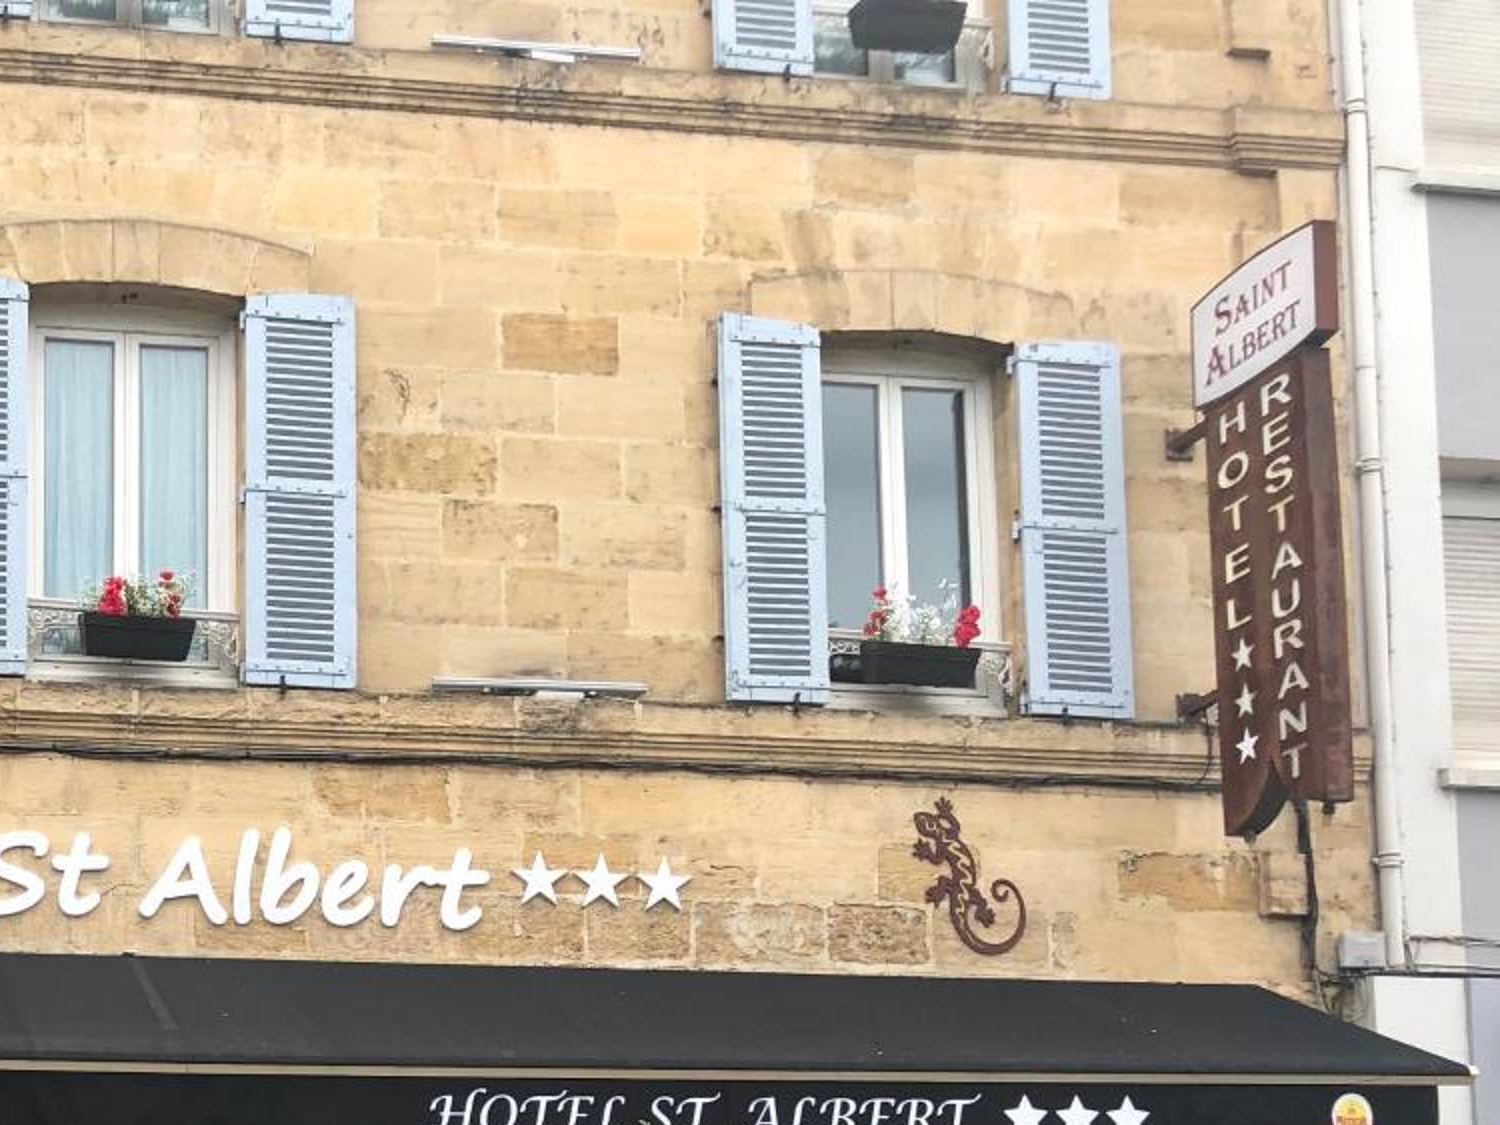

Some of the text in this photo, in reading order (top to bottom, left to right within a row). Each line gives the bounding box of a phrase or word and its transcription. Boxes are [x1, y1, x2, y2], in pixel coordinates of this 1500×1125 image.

[1206, 299, 1301, 386] ALBERT
[1214, 260, 1292, 337] SAINT
[1217, 400, 1252, 631] HOTEL
[1260, 373, 1310, 779] RESTAURANT
[138, 825, 493, 931] Albert
